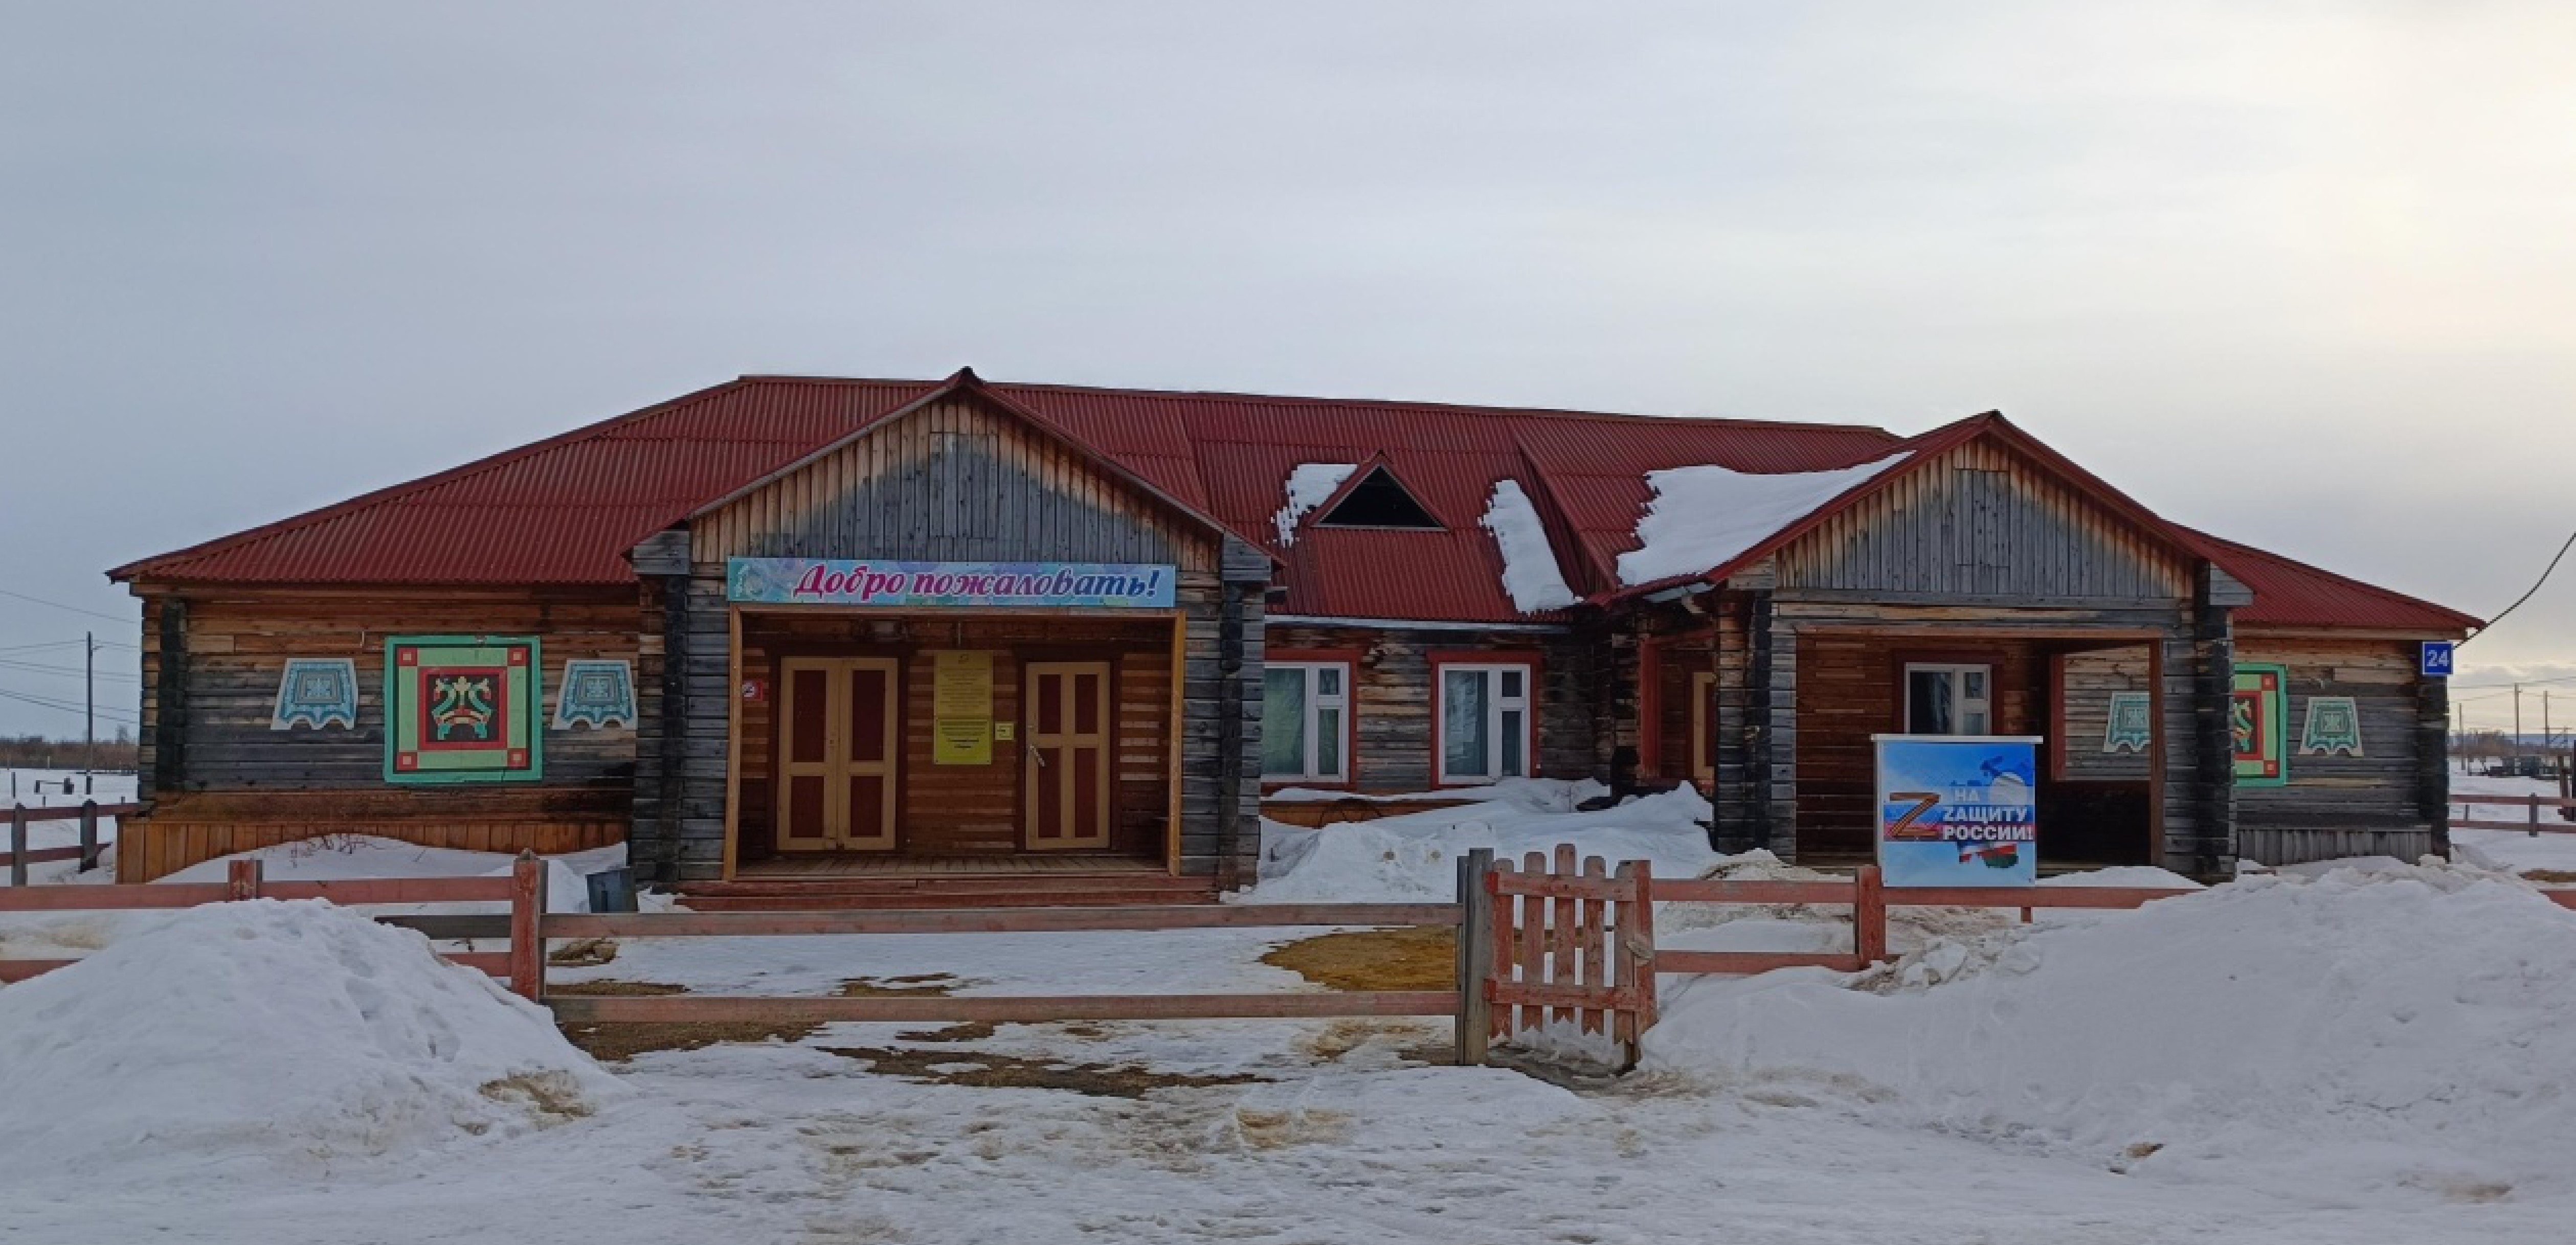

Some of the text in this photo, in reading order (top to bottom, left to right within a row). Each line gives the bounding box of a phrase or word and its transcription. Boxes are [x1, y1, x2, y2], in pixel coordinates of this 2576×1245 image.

[793, 563, 1160, 601] Добро пожаловать!
[2426, 649, 2449, 667] 24
[1954, 788, 1980, 802] НА
[1944, 825, 2034, 840] РОССИИ!
